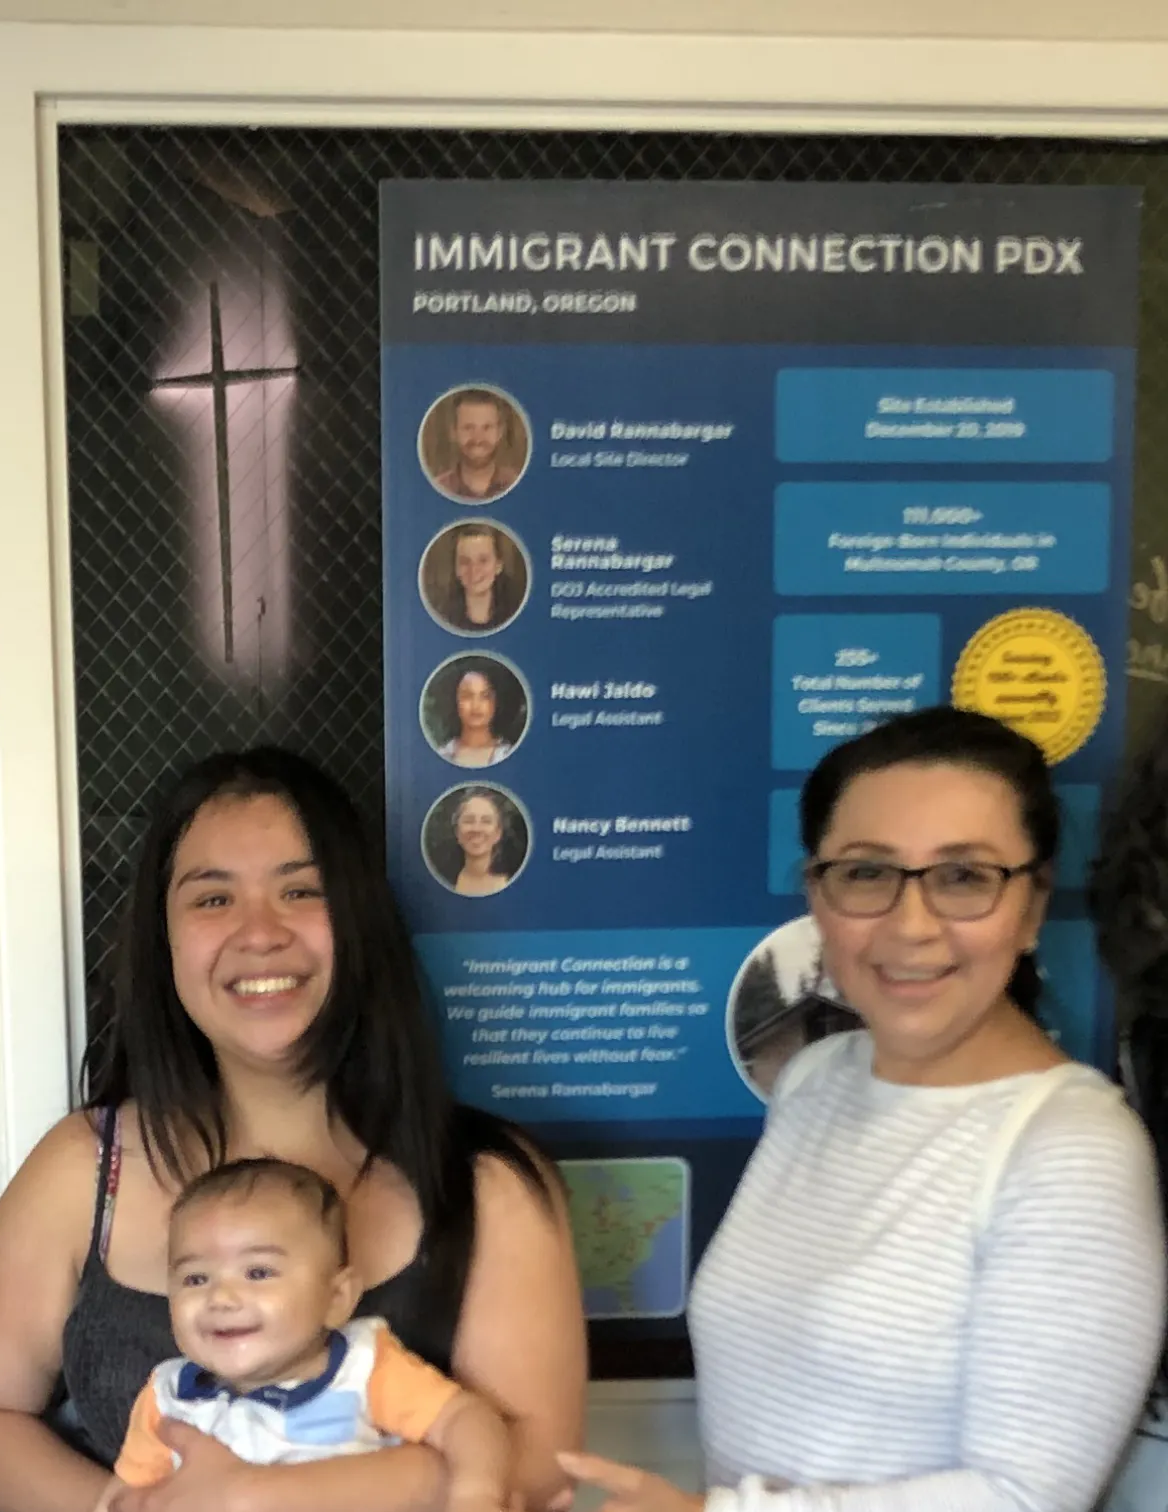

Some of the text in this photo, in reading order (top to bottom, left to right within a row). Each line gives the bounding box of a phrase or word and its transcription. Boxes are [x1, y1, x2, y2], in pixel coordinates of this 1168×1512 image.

[415, 232, 1083, 274] IMMIGRANT CONNECTION PDX
[413, 290, 636, 315] PORTLAND, OREGON
[551, 420, 606, 440] David
[551, 451, 689, 467] Local Site Director
[551, 535, 618, 551] Serena
[552, 711, 663, 729] Legal Assistant
[552, 816, 691, 836] Nancy Bennett
[553, 845, 663, 863] Legal Assistant
[560, 955, 655, 973] Connection
[658, 954, 671, 971] is
[674, 957, 689, 971] a
[443, 980, 534, 999] welcoming
[537, 980, 571, 996] hub
[574, 979, 599, 995] for
[447, 1000, 710, 1022] We guide immigrant families so
[472, 1024, 680, 1045] that they continue to live
[463, 1050, 529, 1067] resilient
[532, 1049, 570, 1065] lives
[573, 1048, 639, 1064] without
[491, 1083, 548, 1099] Serena
